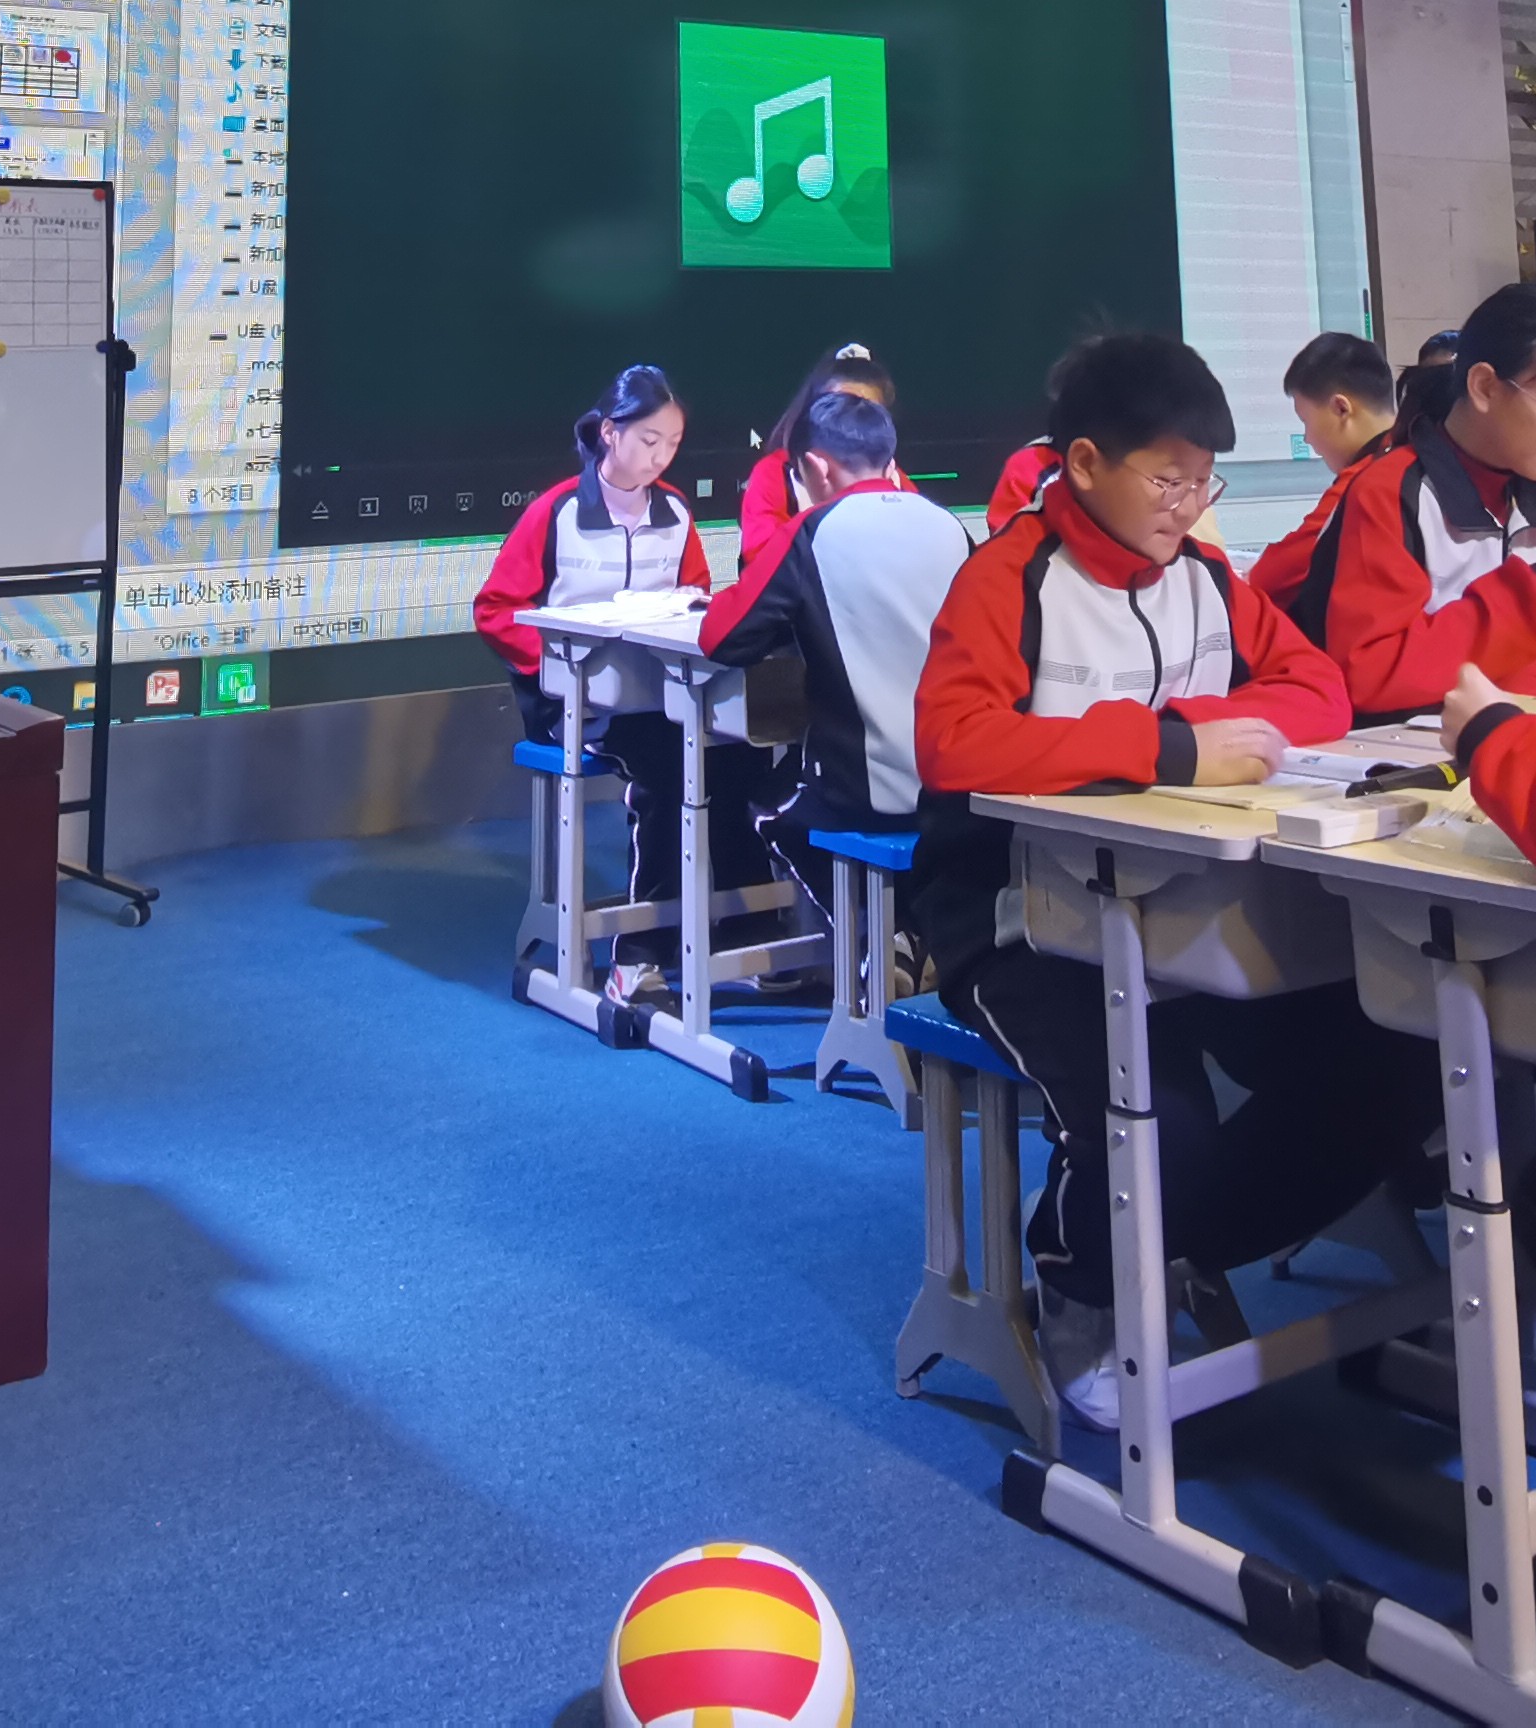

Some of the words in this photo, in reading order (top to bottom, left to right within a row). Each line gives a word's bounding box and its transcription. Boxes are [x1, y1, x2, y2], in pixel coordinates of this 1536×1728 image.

[255, 23, 287, 39] 文档
[255, 53, 287, 70] 下载
[254, 84, 286, 102] 音乐
[253, 116, 285, 133] 桌面
[252, 149, 285, 167] 本地
[204, 483, 253, 503] 个项目
[123, 573, 307, 610] 单击此处添加备注
[293, 616, 369, 638] 中文(中国)
